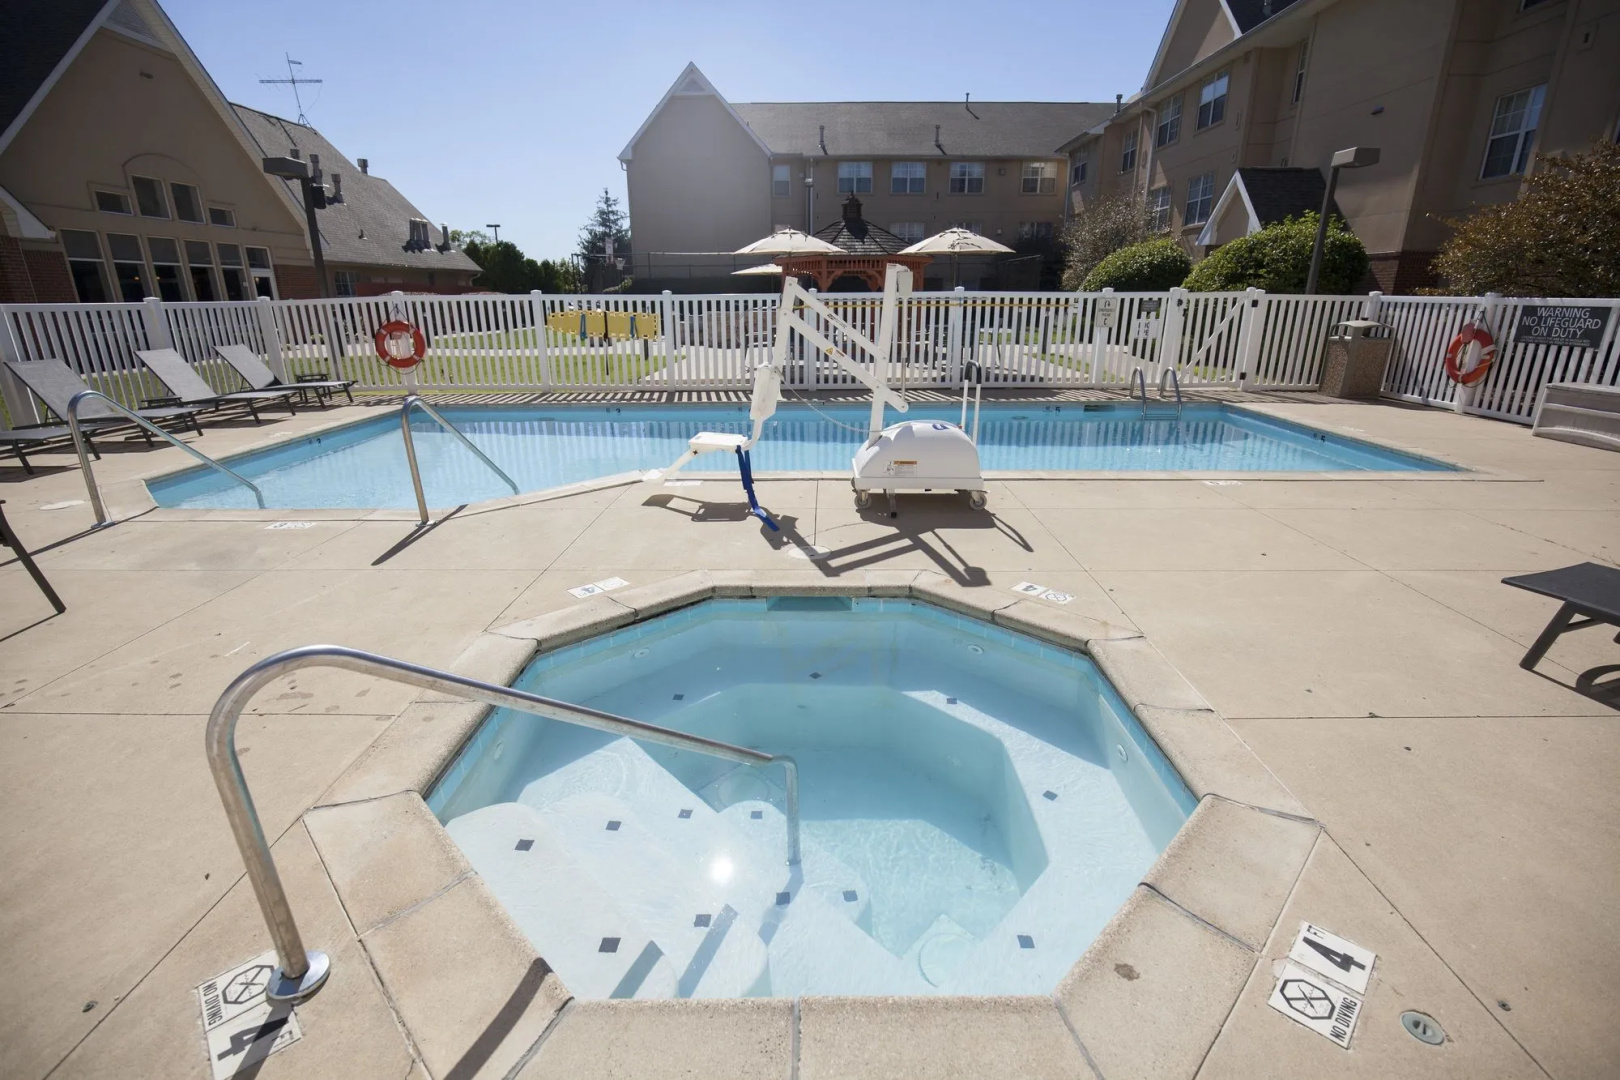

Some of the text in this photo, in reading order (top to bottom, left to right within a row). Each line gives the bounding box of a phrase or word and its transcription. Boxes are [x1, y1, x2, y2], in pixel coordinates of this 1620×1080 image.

[1521, 316, 1602, 329] NO LIFEGUARD
[1531, 326, 1584, 338] ON DUTY
[1537, 307, 1591, 318] WARNING
[1302, 924, 1366, 973] 4 FT
[202, 981, 223, 1027] NO DIVING
[1329, 997, 1358, 1042] NO DIVING
[217, 1016, 289, 1062] 4
